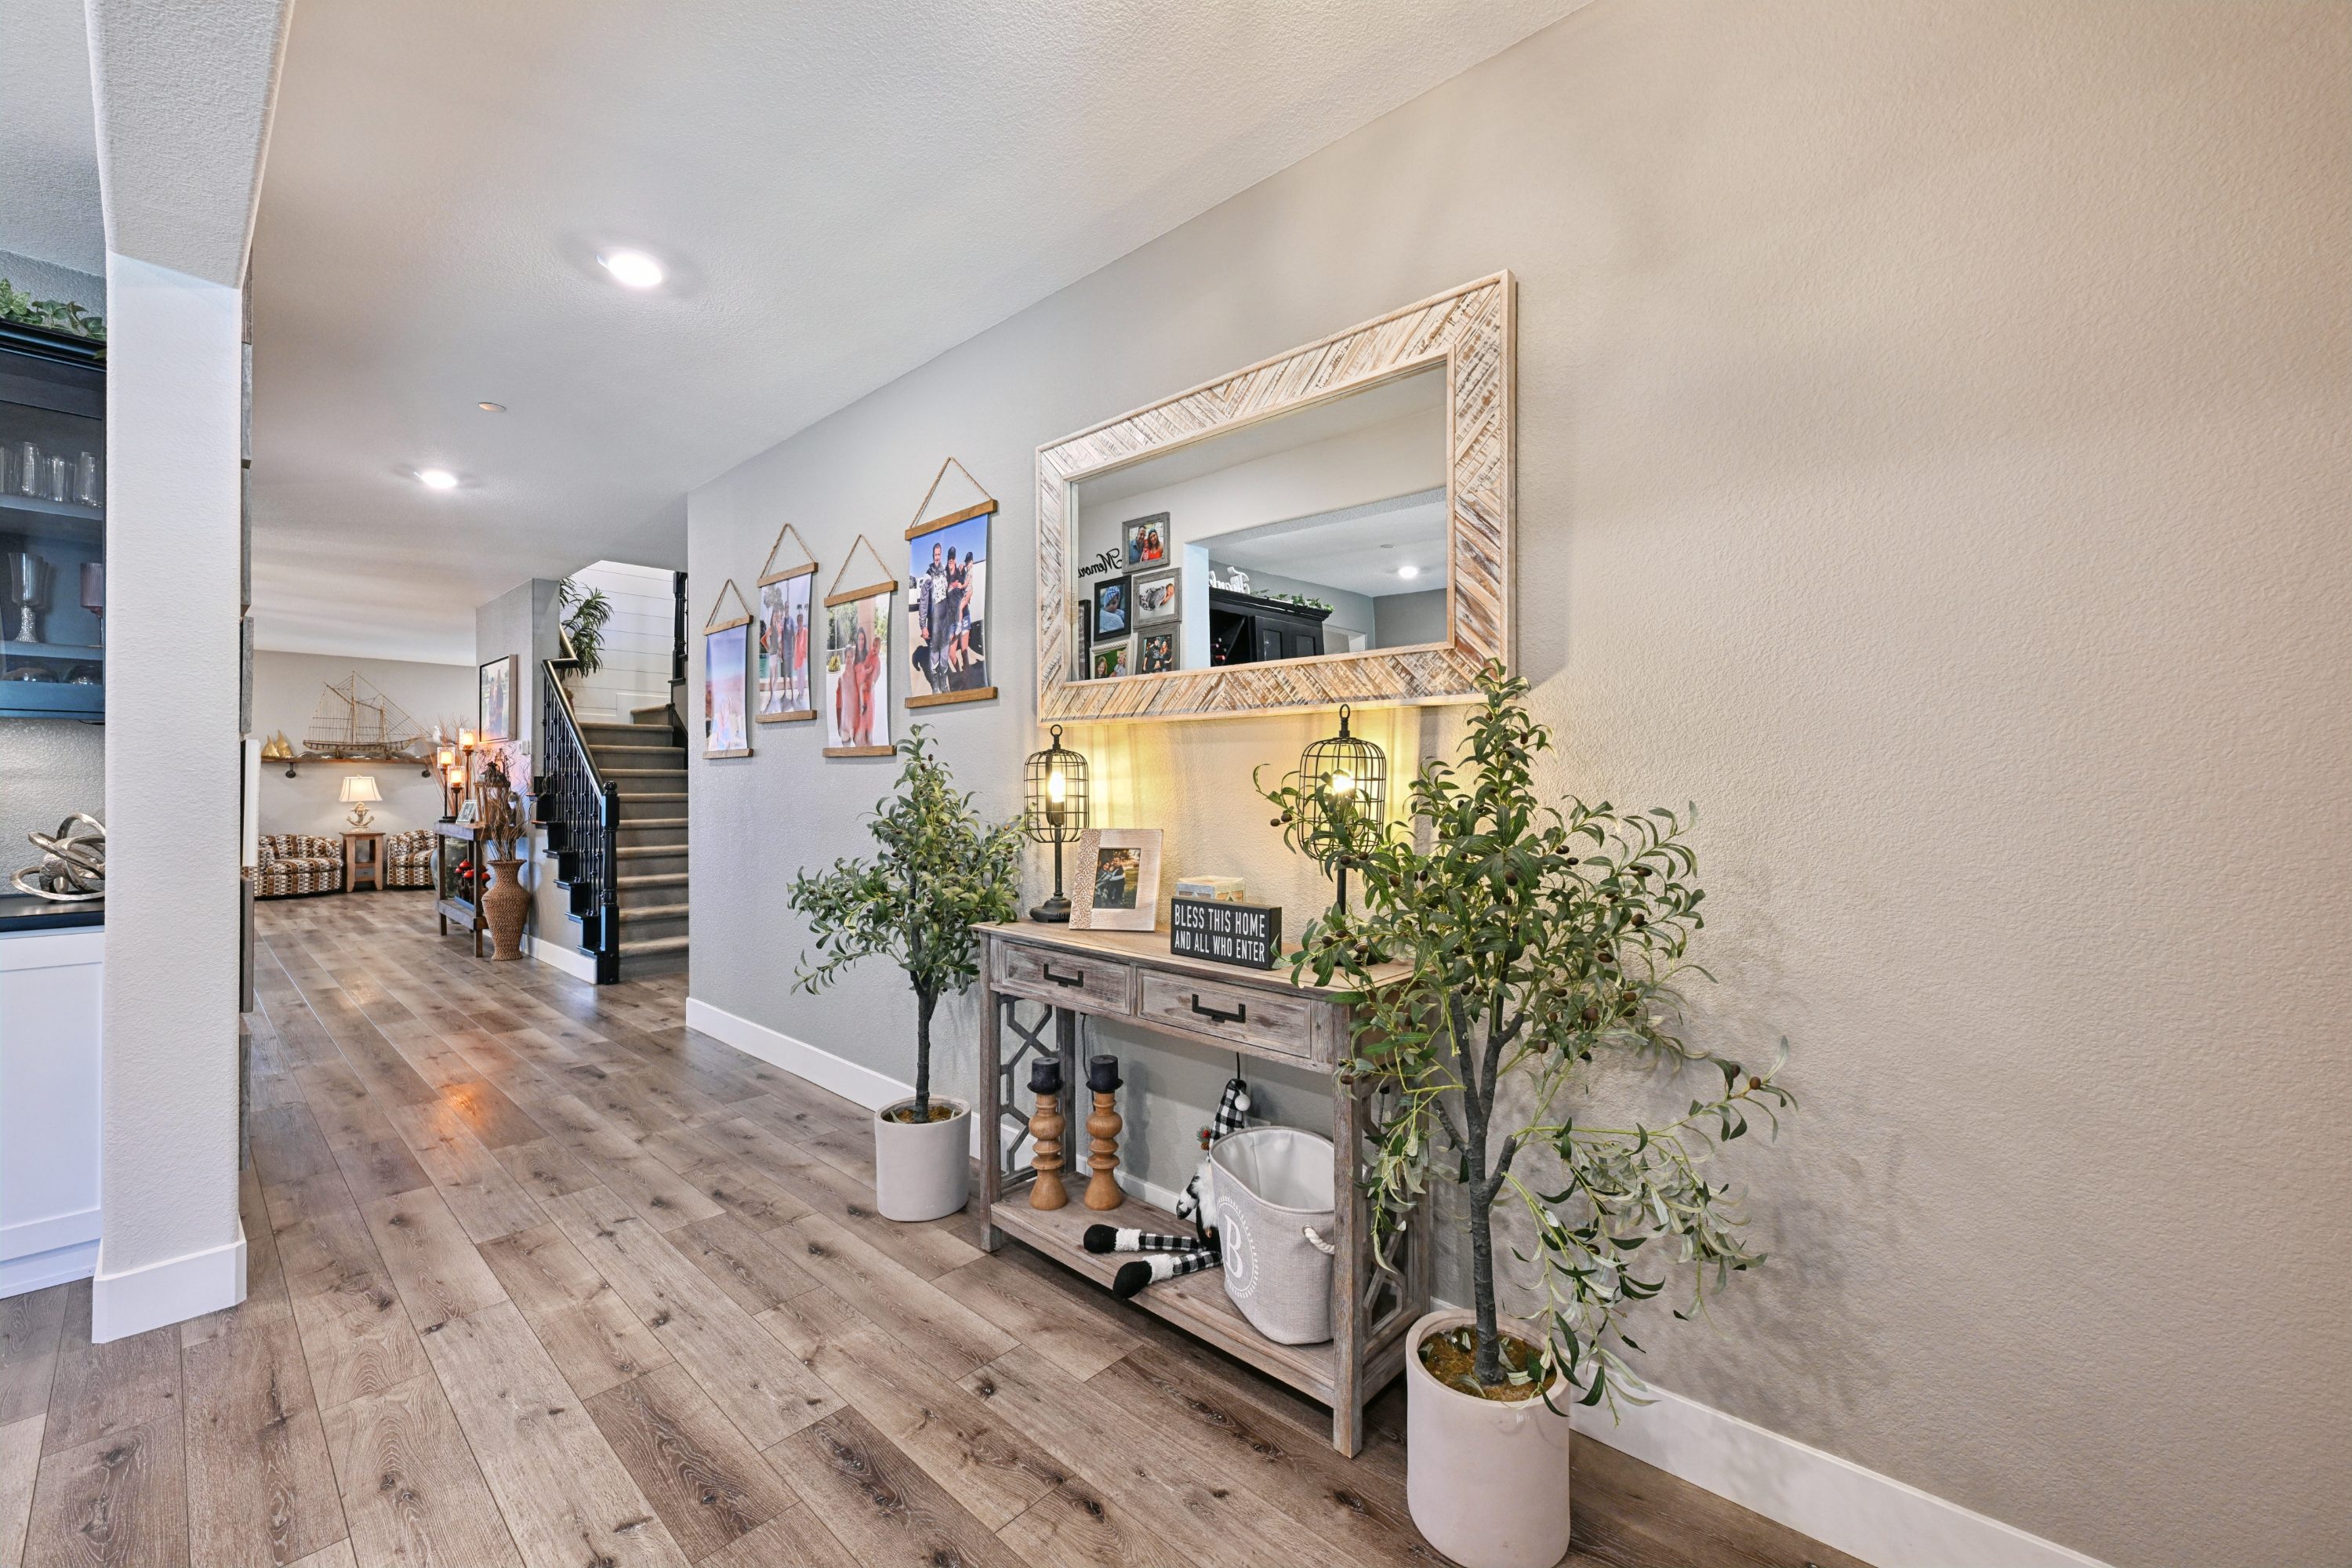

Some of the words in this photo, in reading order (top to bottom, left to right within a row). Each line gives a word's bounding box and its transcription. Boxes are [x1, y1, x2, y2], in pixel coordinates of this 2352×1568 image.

[1174, 904, 1205, 929] BLESS
[1208, 908, 1231, 933] THIS
[1235, 911, 1265, 938] HOME
[1174, 930, 1191, 950] AND
[1194, 932, 1210, 953] ALL
[1213, 935, 1232, 957] WHO
[1236, 938, 1265, 963] ENTER
[1225, 1214, 1243, 1279] B
